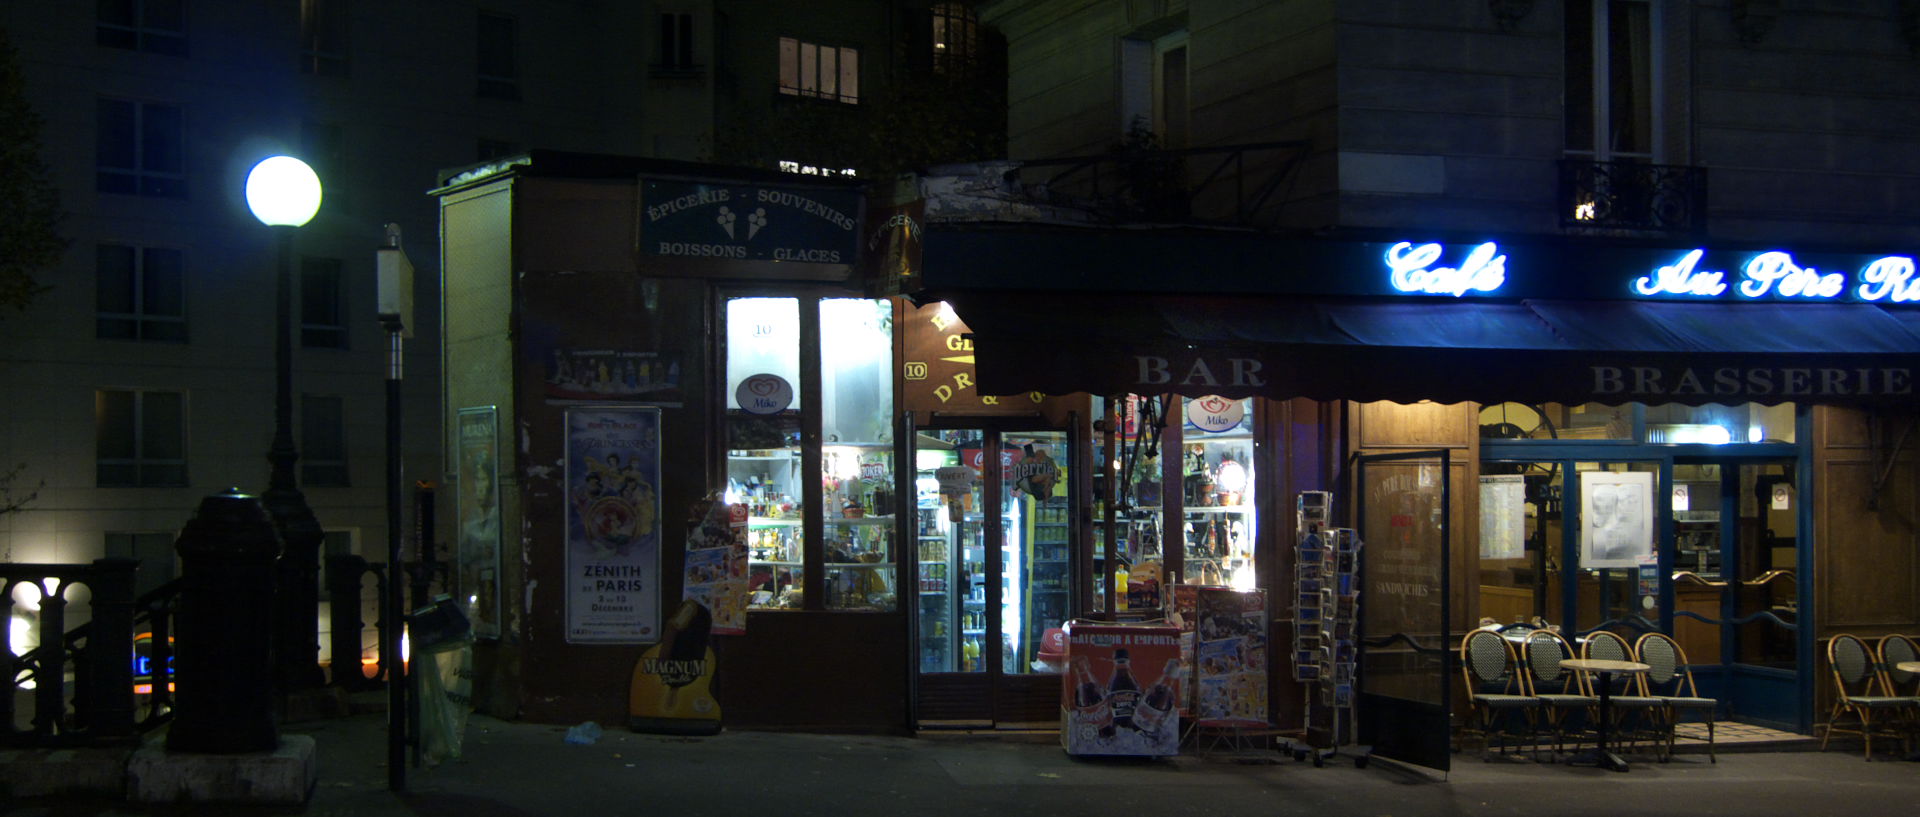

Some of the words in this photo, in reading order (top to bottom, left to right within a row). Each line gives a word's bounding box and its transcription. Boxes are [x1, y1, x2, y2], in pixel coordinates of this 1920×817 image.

[757, 189, 856, 231] SOUVENIRS
[659, 242, 747, 259] BOISSONS
[773, 247, 841, 264] GLACES
[1384, 241, 1507, 298] Café
[1629, 249, 1727, 296] Au
[906, 364, 926, 378] 10
[1133, 354, 1267, 387] BAR
[1590, 365, 1913, 396] BRASSERIE
[754, 398, 777, 409] Miko
[1205, 415, 1229, 426] Miko
[596, 580, 642, 592] PARIS
[643, 658, 705, 675] MAGNUM
